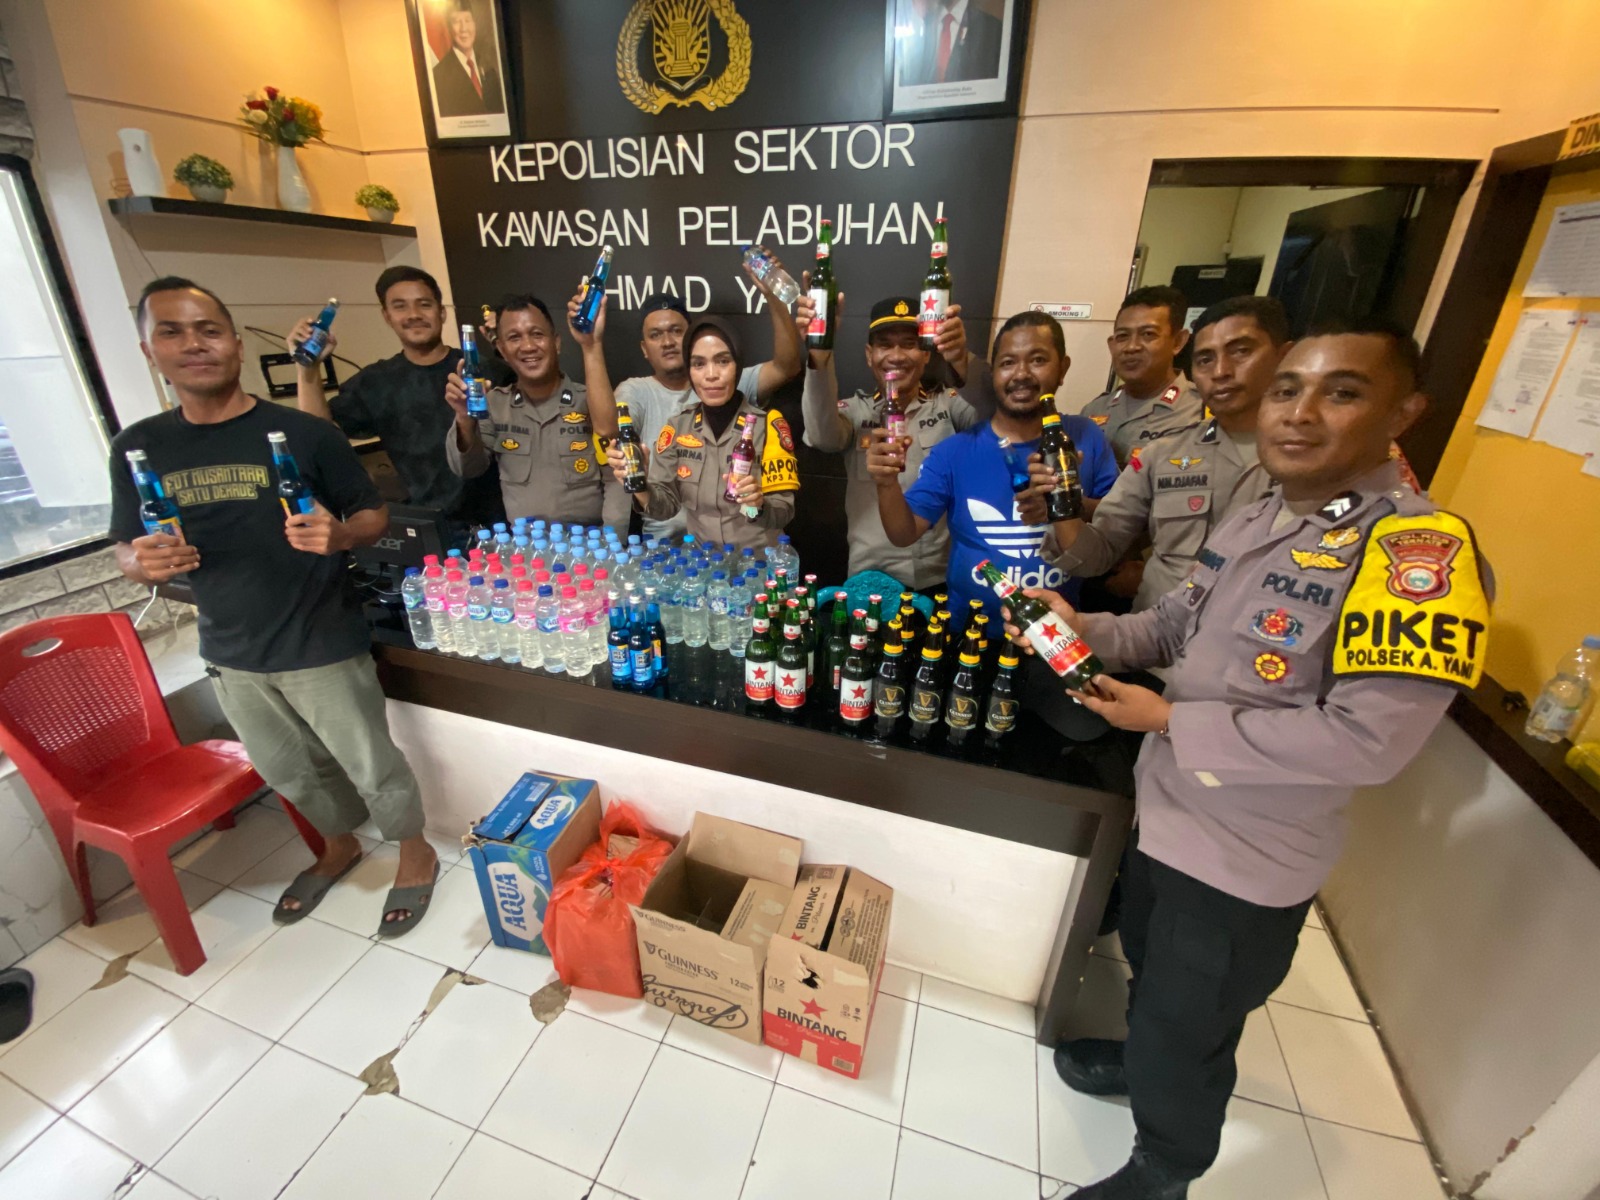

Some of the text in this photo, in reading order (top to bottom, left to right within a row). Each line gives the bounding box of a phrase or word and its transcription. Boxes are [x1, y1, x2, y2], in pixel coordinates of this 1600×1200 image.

[490, 123, 915, 183] KEPOLISIAN SEKTOR
[477, 202, 944, 248] KAWASAN PELABUHAN
[192, 465, 267, 486] NUSANTARA
[179, 485, 255, 505] SATU DEKADE
[1261, 571, 1334, 607] POLRI
[1342, 609, 1485, 660] PIKET
[1346, 648, 1475, 680] POLSEK A. YANI
[537, 800, 563, 825] AQUA
[495, 873, 527, 931] AQUA
[796, 886, 821, 930] BINTANG
[645, 913, 686, 932] GUINNESS
[657, 948, 719, 980] GUINNESS
[729, 977, 740, 987] 12
[773, 977, 785, 987] 12
[777, 1007, 848, 1042] BINTANG
